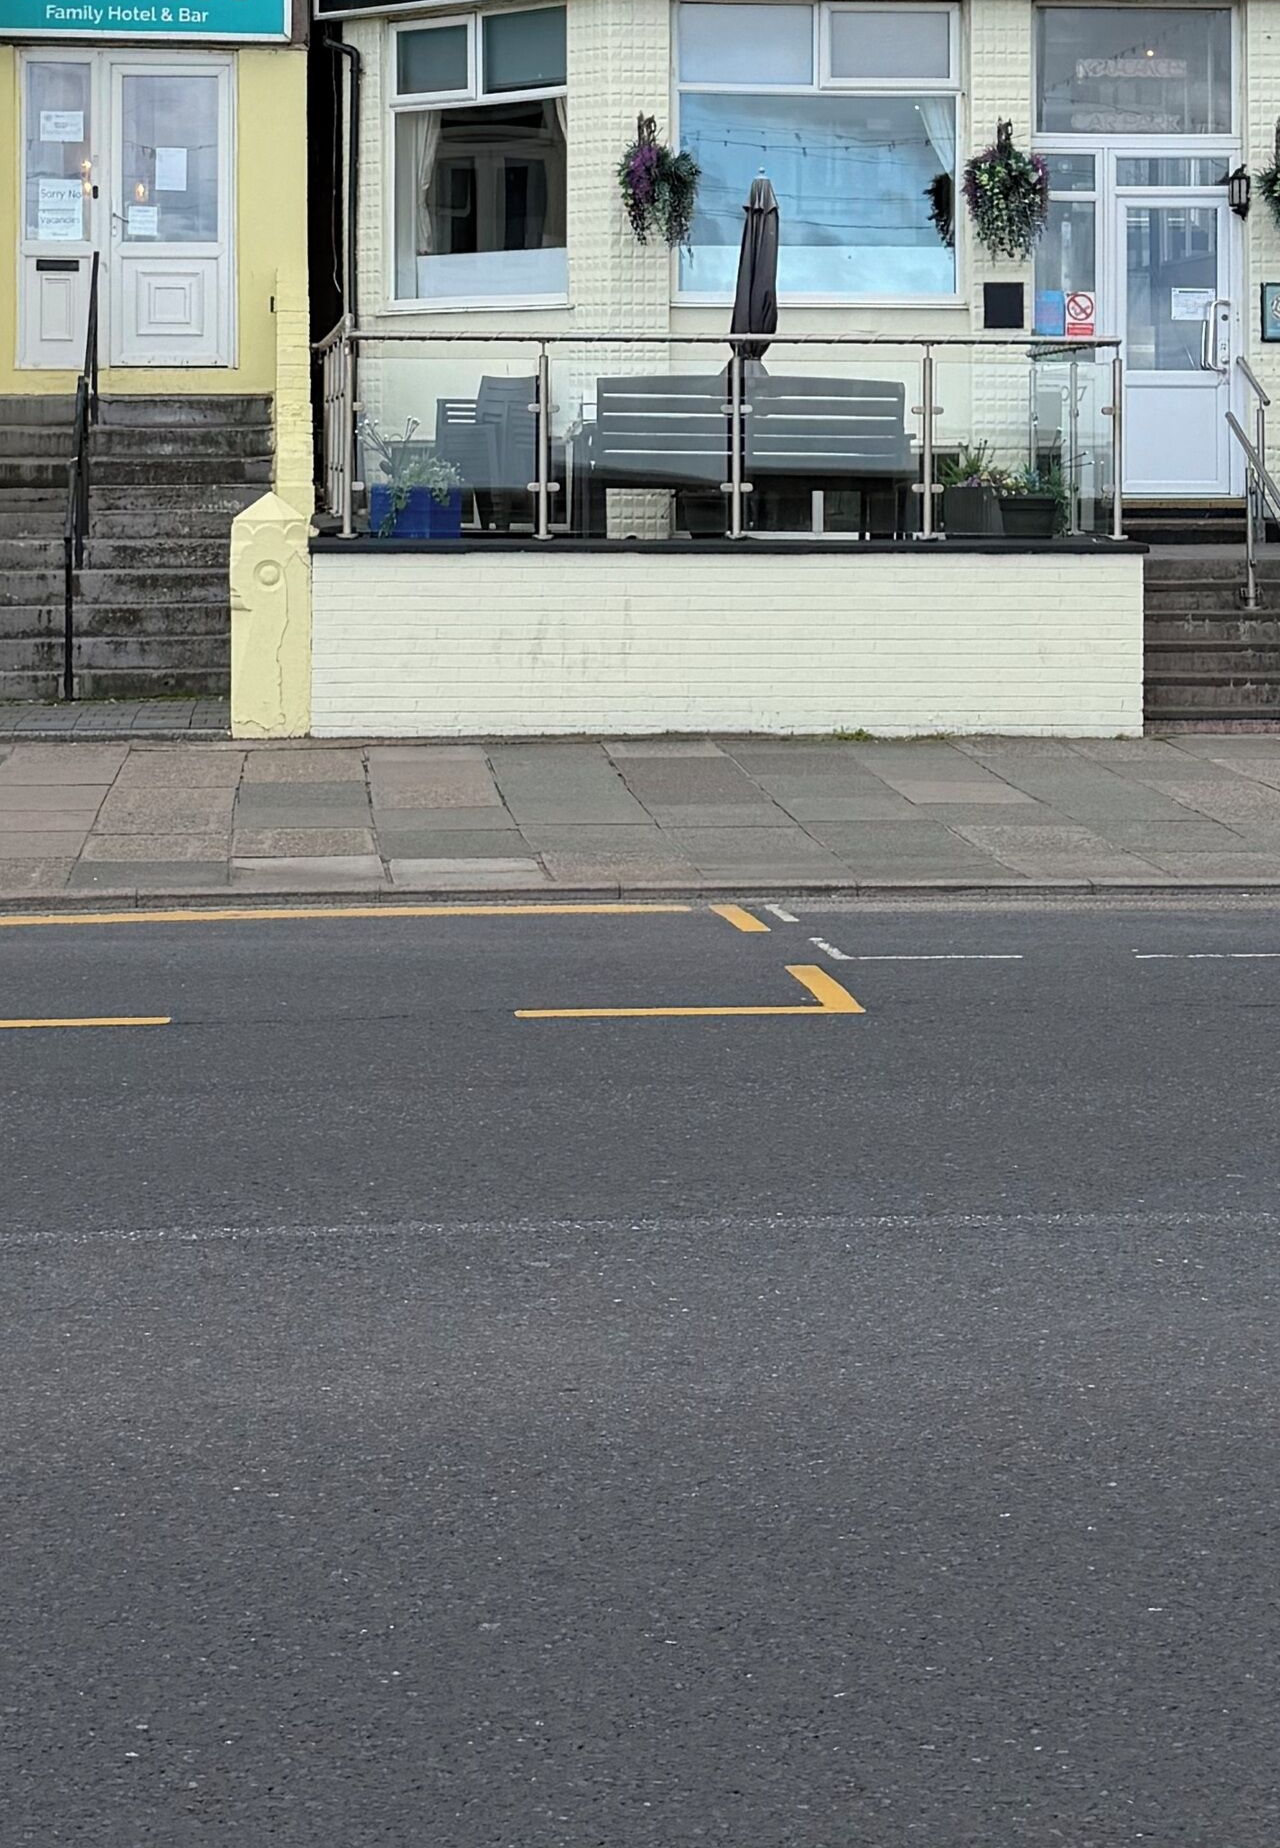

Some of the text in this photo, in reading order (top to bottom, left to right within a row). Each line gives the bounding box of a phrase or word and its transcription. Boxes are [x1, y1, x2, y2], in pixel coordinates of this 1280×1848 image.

[46, 4, 209, 24] Family Hotel & Bar
[40, 189, 82, 200] Sorry No
